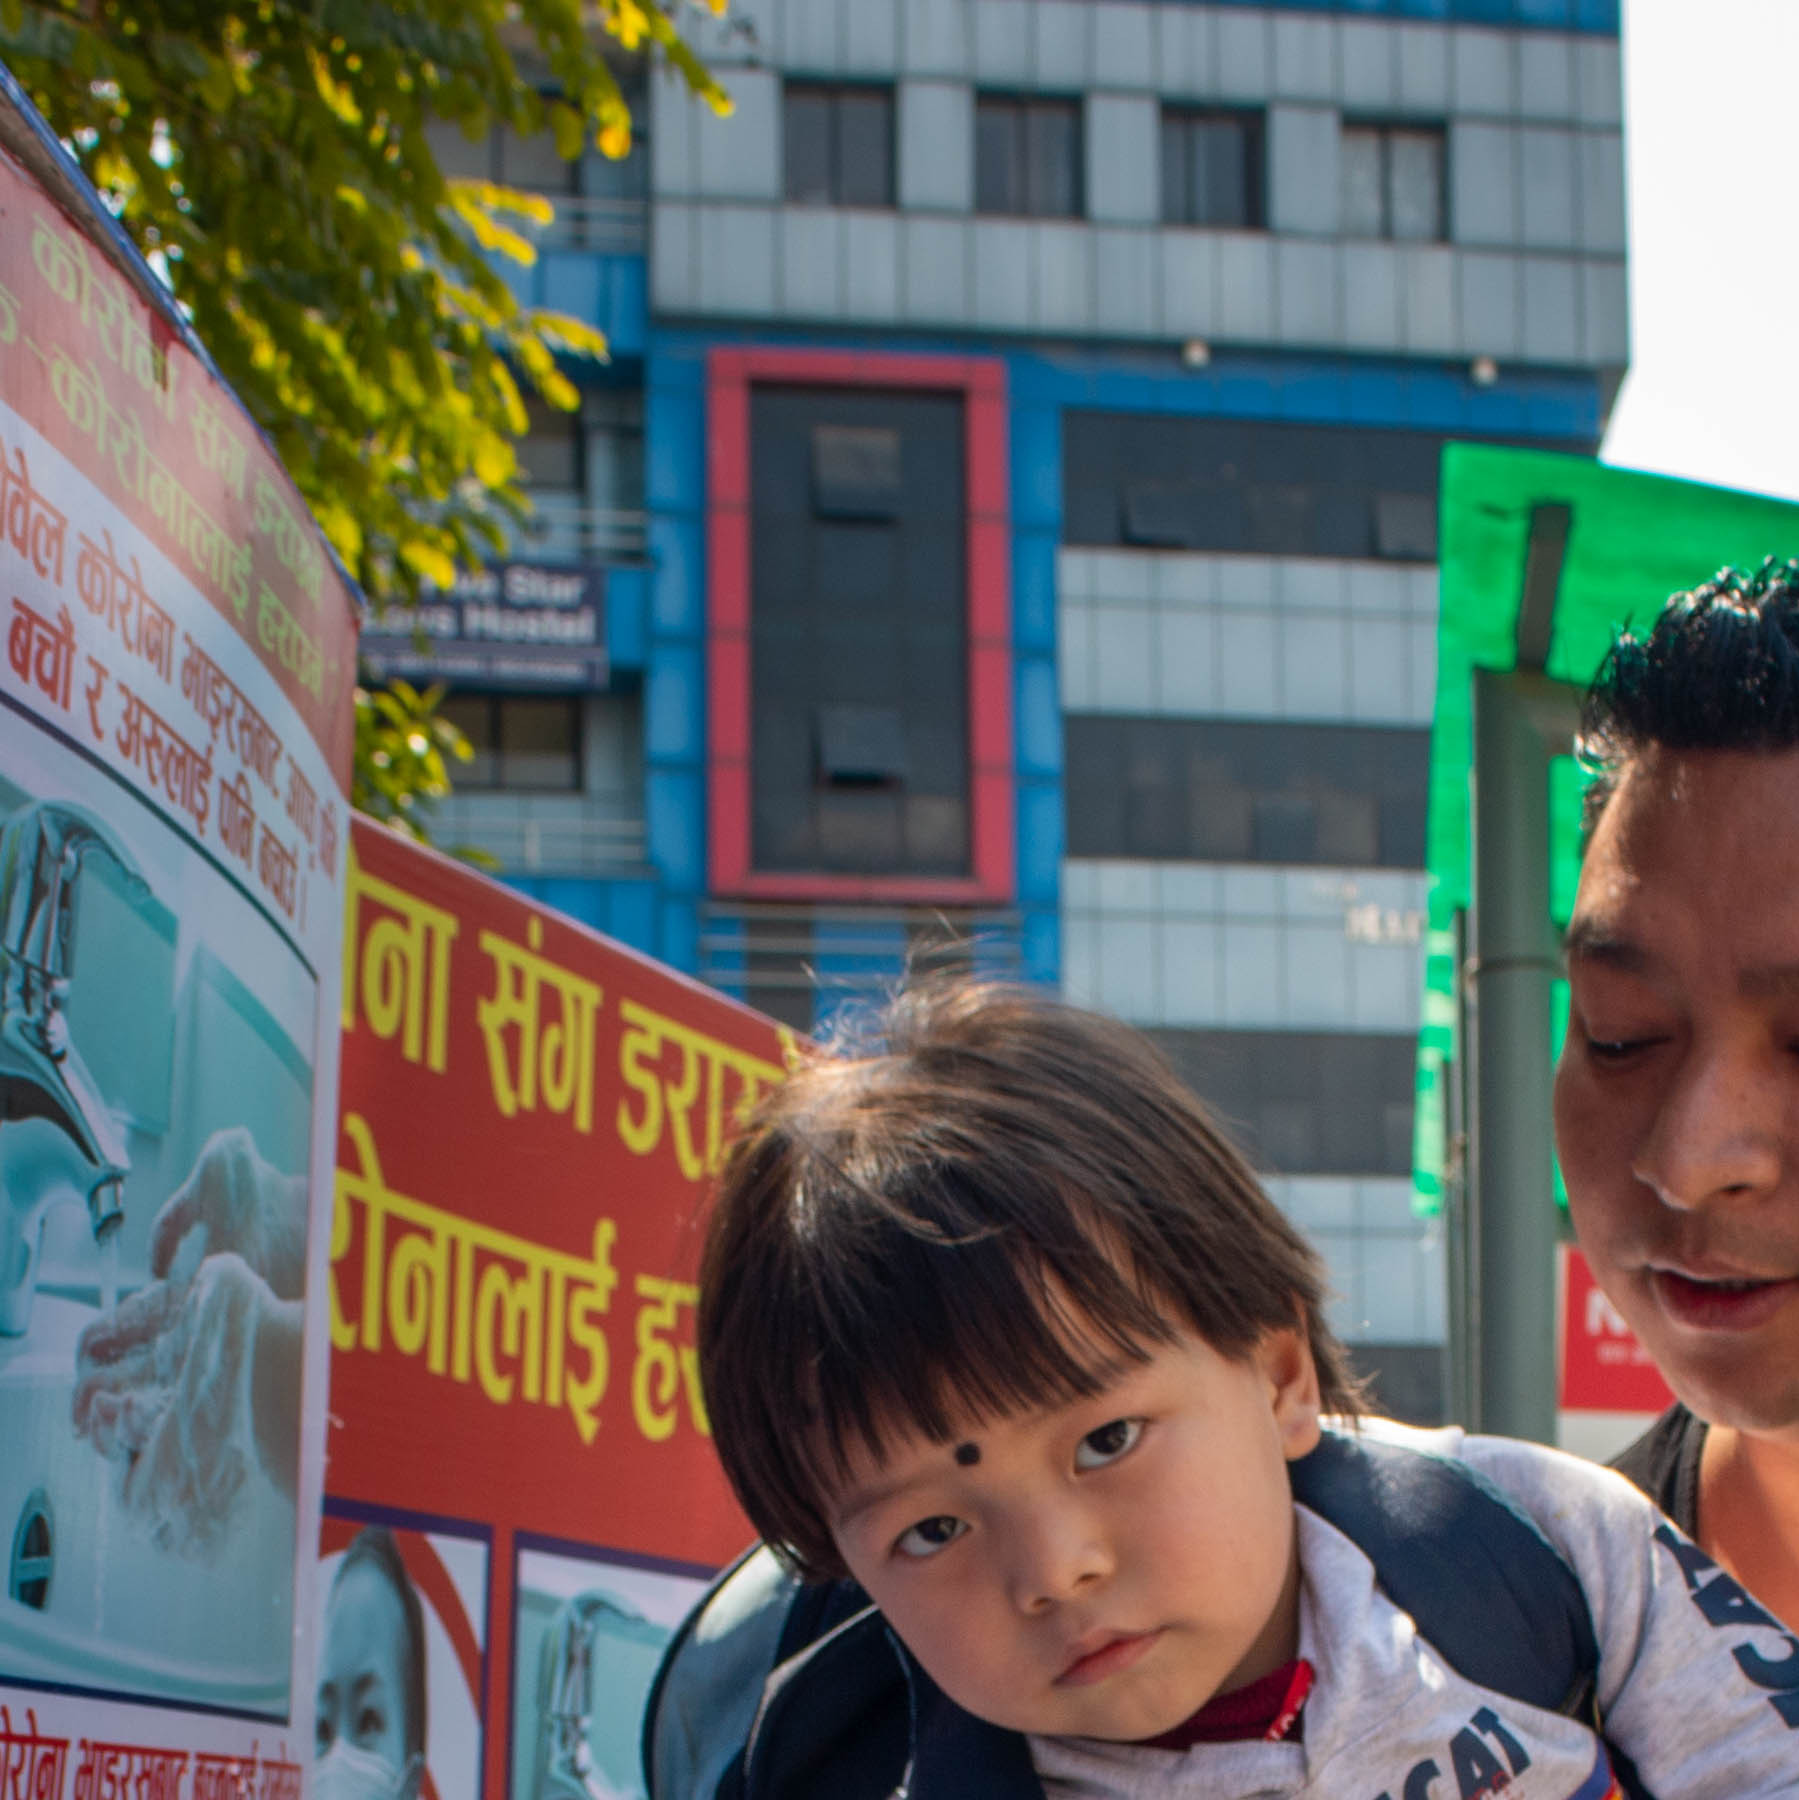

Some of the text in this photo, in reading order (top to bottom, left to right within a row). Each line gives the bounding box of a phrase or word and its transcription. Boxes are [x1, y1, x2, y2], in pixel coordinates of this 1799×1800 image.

[76, 526, 176, 685] कोरोना
[84, 653, 109, 742] र
[477, 915, 602, 1136] संग
